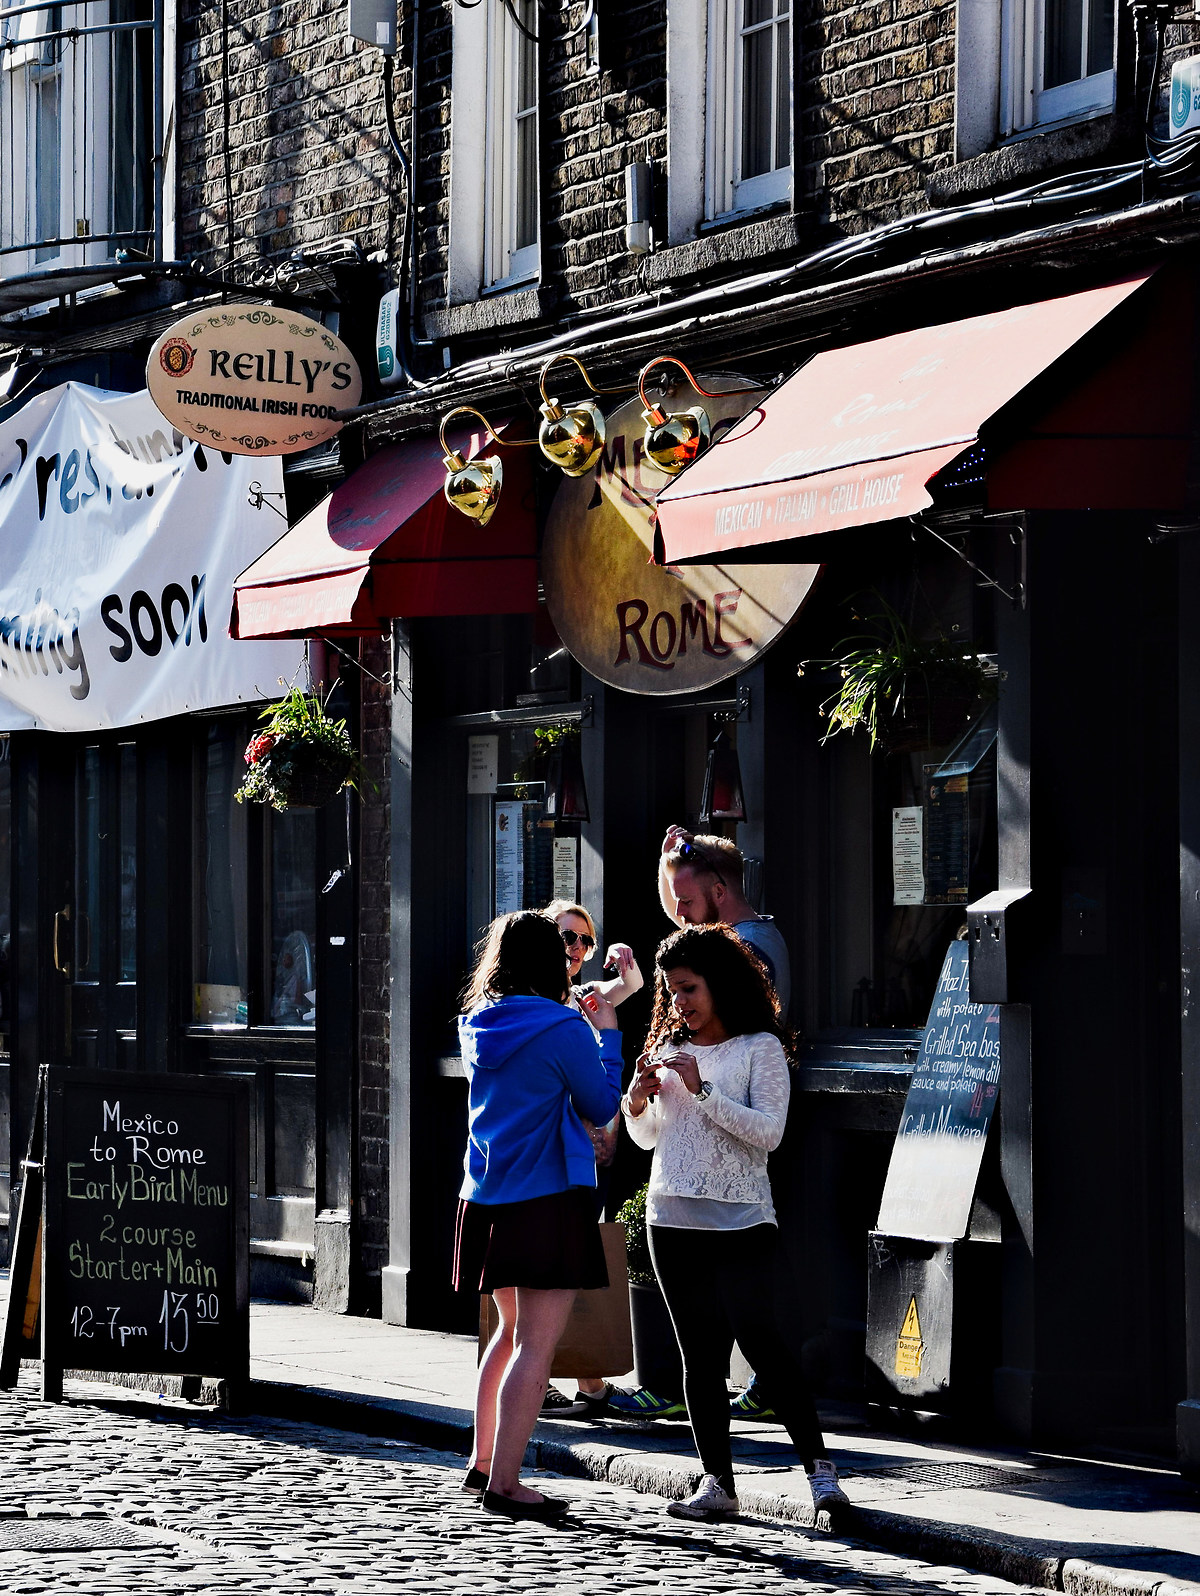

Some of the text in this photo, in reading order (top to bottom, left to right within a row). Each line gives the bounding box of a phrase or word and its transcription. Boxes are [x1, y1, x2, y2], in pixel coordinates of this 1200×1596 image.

[176, 389, 338, 422] TRADITIONAL IRISH FOOD
[714, 474, 904, 537] MEXICAN ITALIAN GRILL HOUSE
[100, 574, 208, 663] soon
[615, 588, 753, 670] ROME
[951, 998, 983, 1027] potato
[924, 1020, 1000, 1059] Grilled Sea bas
[911, 1078, 934, 1090] sauce
[936, 1075, 950, 1092] and
[949, 1078, 977, 1099] potato
[917, 1057, 1000, 1084] with creamy lemon dill
[103, 1100, 179, 1135] Mexico
[903, 1112, 936, 1145] Grilled
[89, 1135, 206, 1169] to Rome
[67, 1162, 228, 1209] Early Bird Menu
[100, 1214, 197, 1248] 2 course
[899, 1341, 919, 1353] Dange
